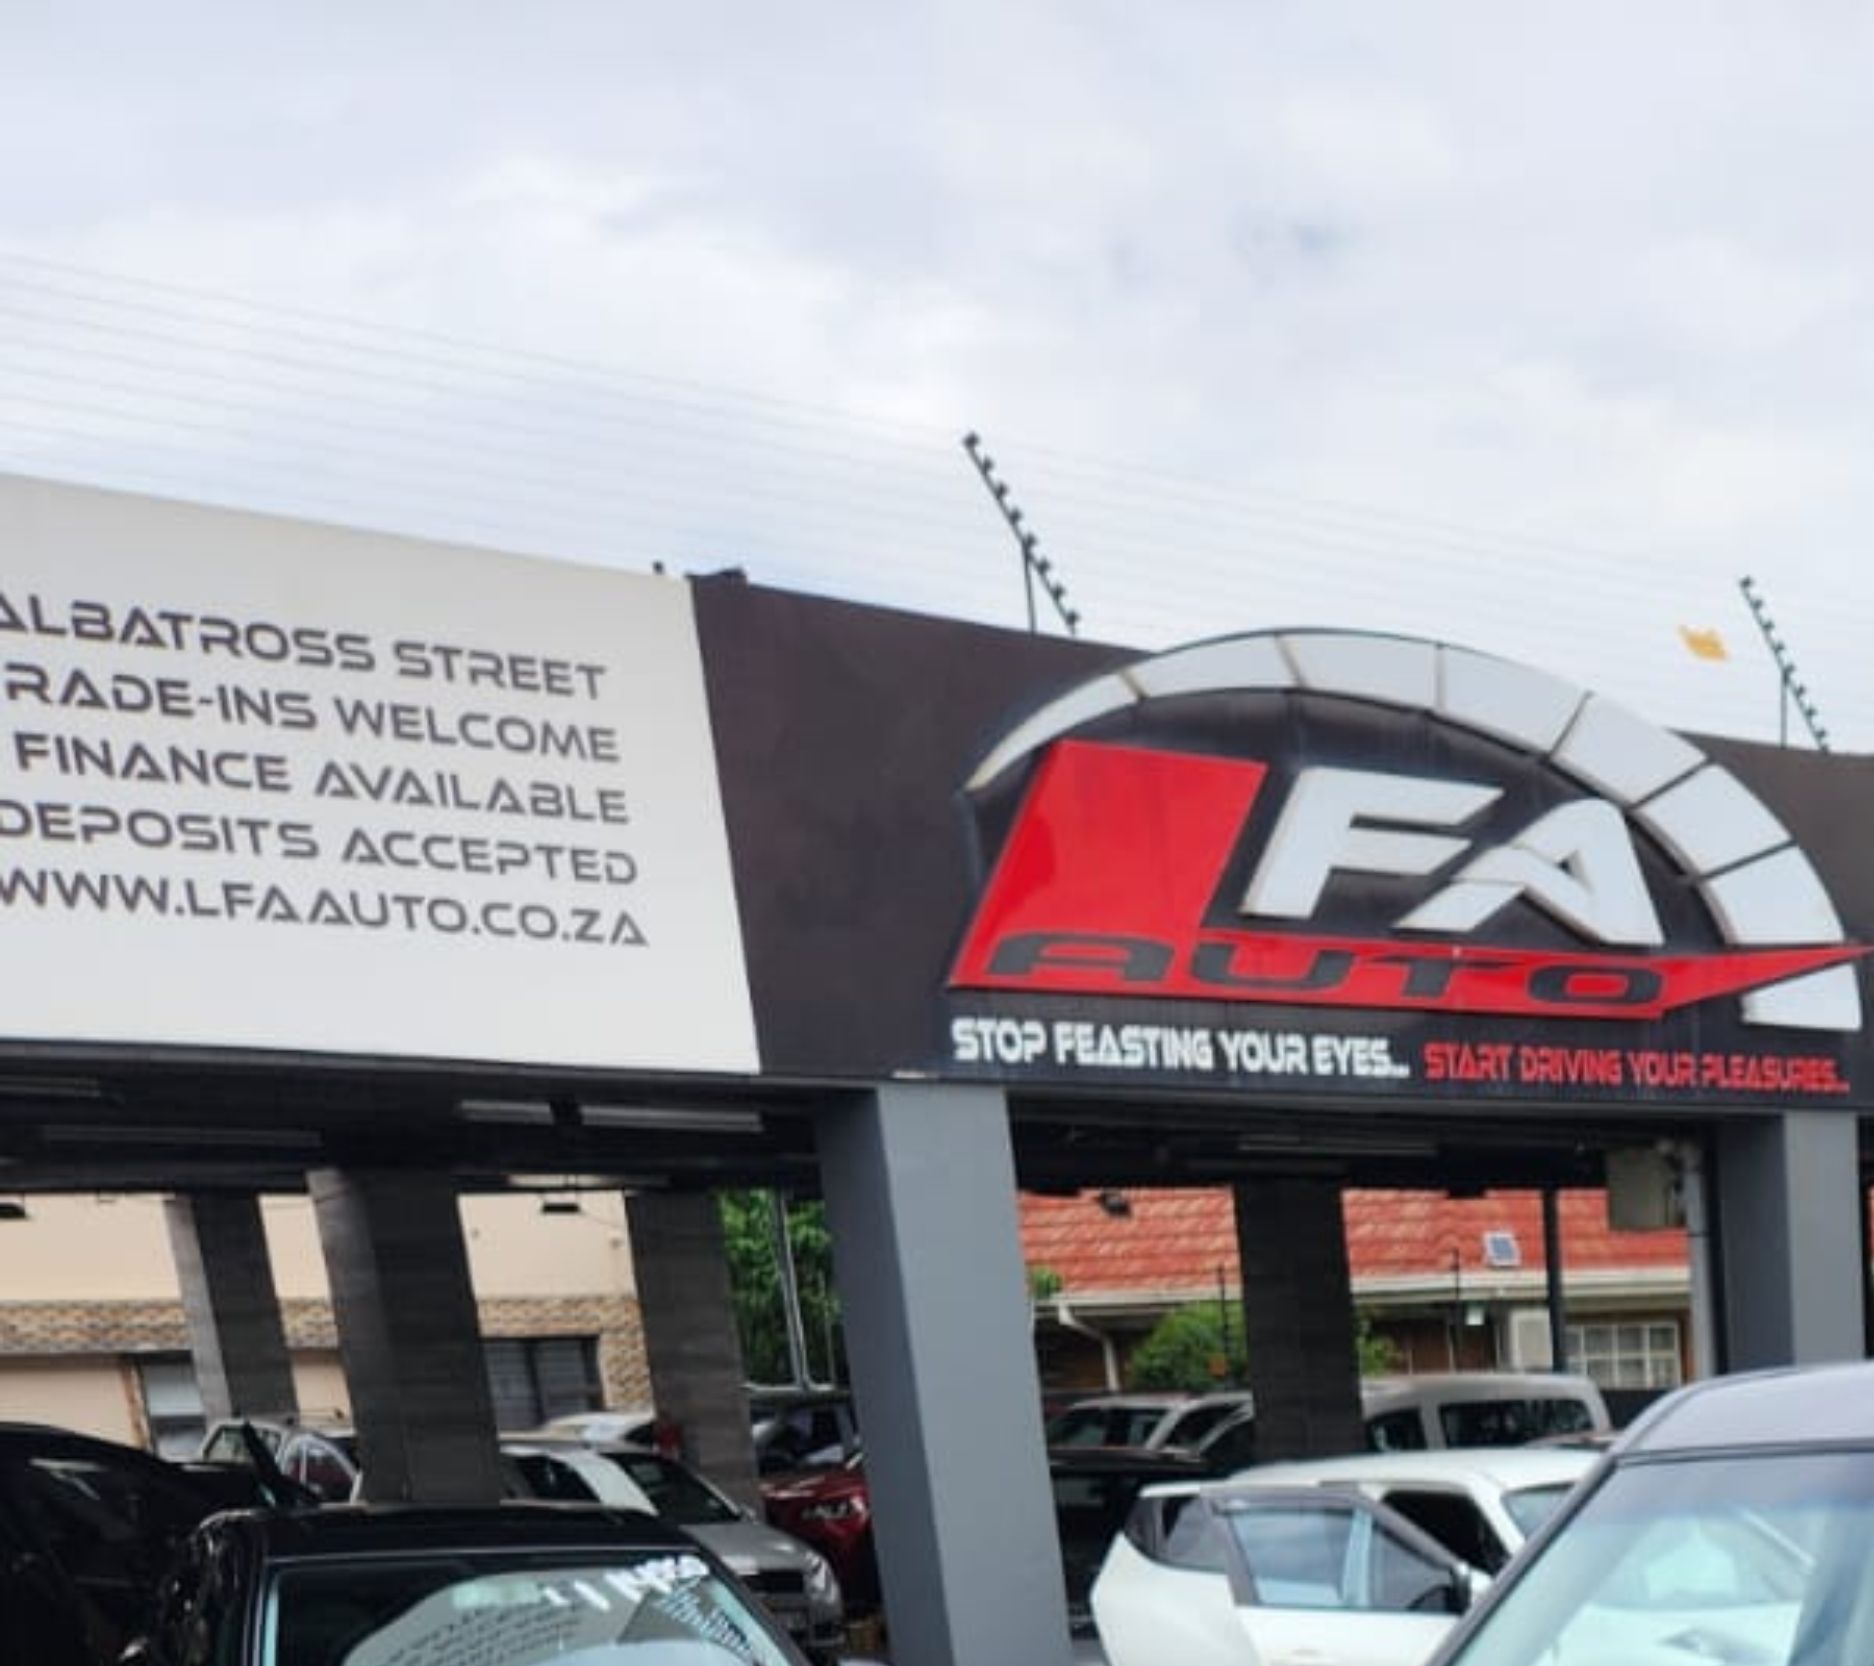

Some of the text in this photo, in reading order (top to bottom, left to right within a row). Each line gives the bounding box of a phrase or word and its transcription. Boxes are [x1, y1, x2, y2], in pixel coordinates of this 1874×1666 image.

[393, 640, 607, 700] STREET
[334, 697, 620, 763] WELCOME
[13, 732, 630, 825] FINANCE AVAILABLE
[0, 799, 638, 886] DEPOSITS ACCEPTED
[0, 869, 649, 948] WWW.LFAAUTO.CO.ZA
[988, 931, 1665, 1003] AUTO
[951, 1017, 1047, 1063] STOP
[1054, 1023, 1213, 1070] FEASTING
[1217, 1029, 1308, 1074] YOUR
[1424, 1043, 1512, 1080] START
[1520, 1047, 1623, 1085] DRIVING
[1627, 1052, 1697, 1087] YOUR
